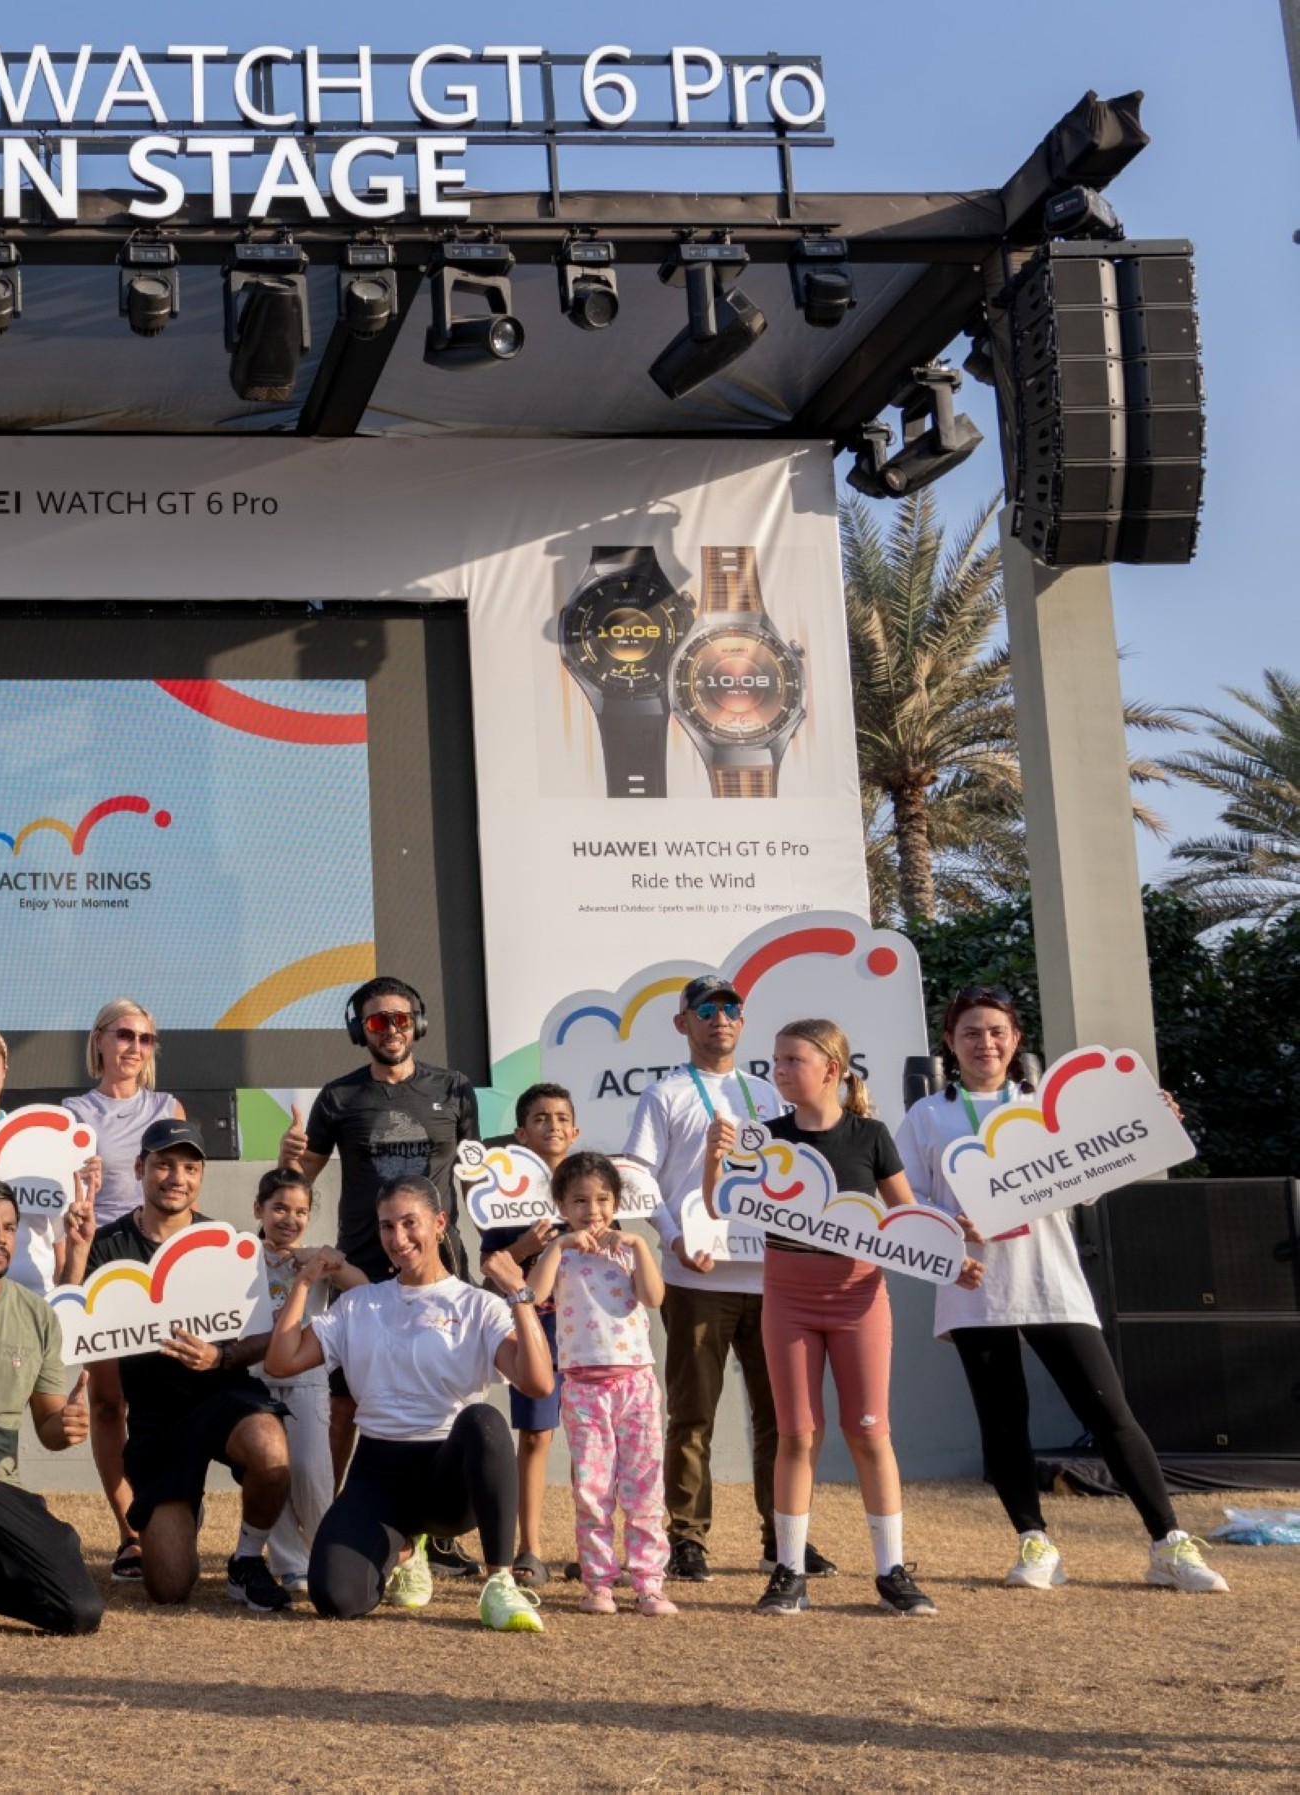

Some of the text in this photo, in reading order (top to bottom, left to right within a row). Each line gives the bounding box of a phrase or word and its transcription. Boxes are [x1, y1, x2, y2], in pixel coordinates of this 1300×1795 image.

[408, 44, 542, 128] GT
[581, 45, 637, 128] 6
[671, 46, 826, 130] Pro
[128, 137, 471, 221] STAGE
[36, 491, 146, 515] WATCH
[156, 491, 196, 515] GT
[206, 491, 222, 515] 6
[233, 491, 278, 515] Pro
[597, 625, 661, 638] 10:08
[706, 675, 770, 687] 10:08
[572, 841, 809, 857] HUAWEI WATCH GT 6 Pro
[86, 872, 152, 890] RINGS
[632, 873, 756, 888] Ride the Wind
[19, 898, 129, 911] Enjoy Your Moment
[597, 1066, 680, 1098] ACT
[989, 1119, 1149, 1197] ACTIVE RINGS
[1020, 1153, 1137, 1205] Enjoy Your Moment
[13, 1186, 65, 1208] INGS
[490, 1200, 556, 1219] DISCOV
[712, 1235, 764, 1254] ACTI
[737, 1196, 953, 1278] DISCOVER HUAWEI
[74, 1322, 162, 1355] ACTIVE
